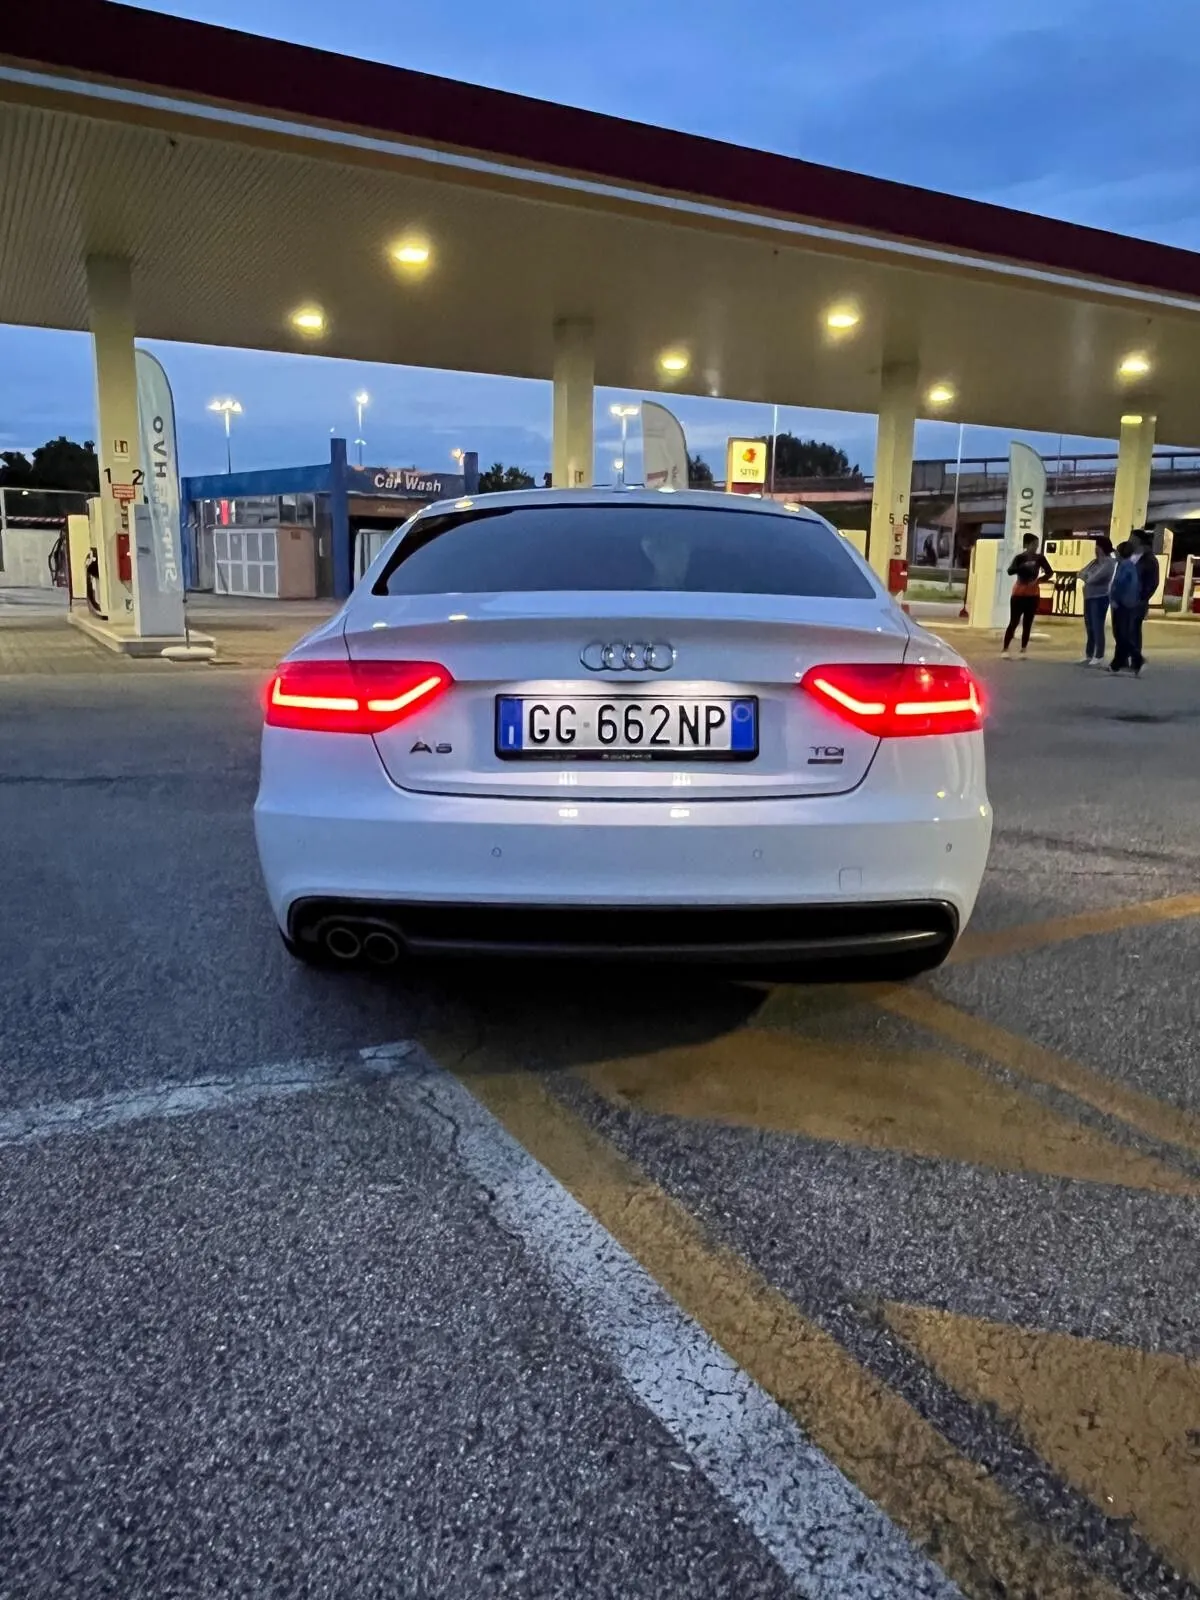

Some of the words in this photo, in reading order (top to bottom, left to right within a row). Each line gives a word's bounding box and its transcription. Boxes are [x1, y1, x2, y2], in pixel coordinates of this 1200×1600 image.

[103, 467, 112, 485] 1
[132, 468, 145, 486] 2
[374, 473, 401, 489] Car
[405, 474, 441, 492] Wash
[888, 512, 895, 525] 5
[528, 704, 577, 744] GG
[597, 704, 726, 745] 662NP
